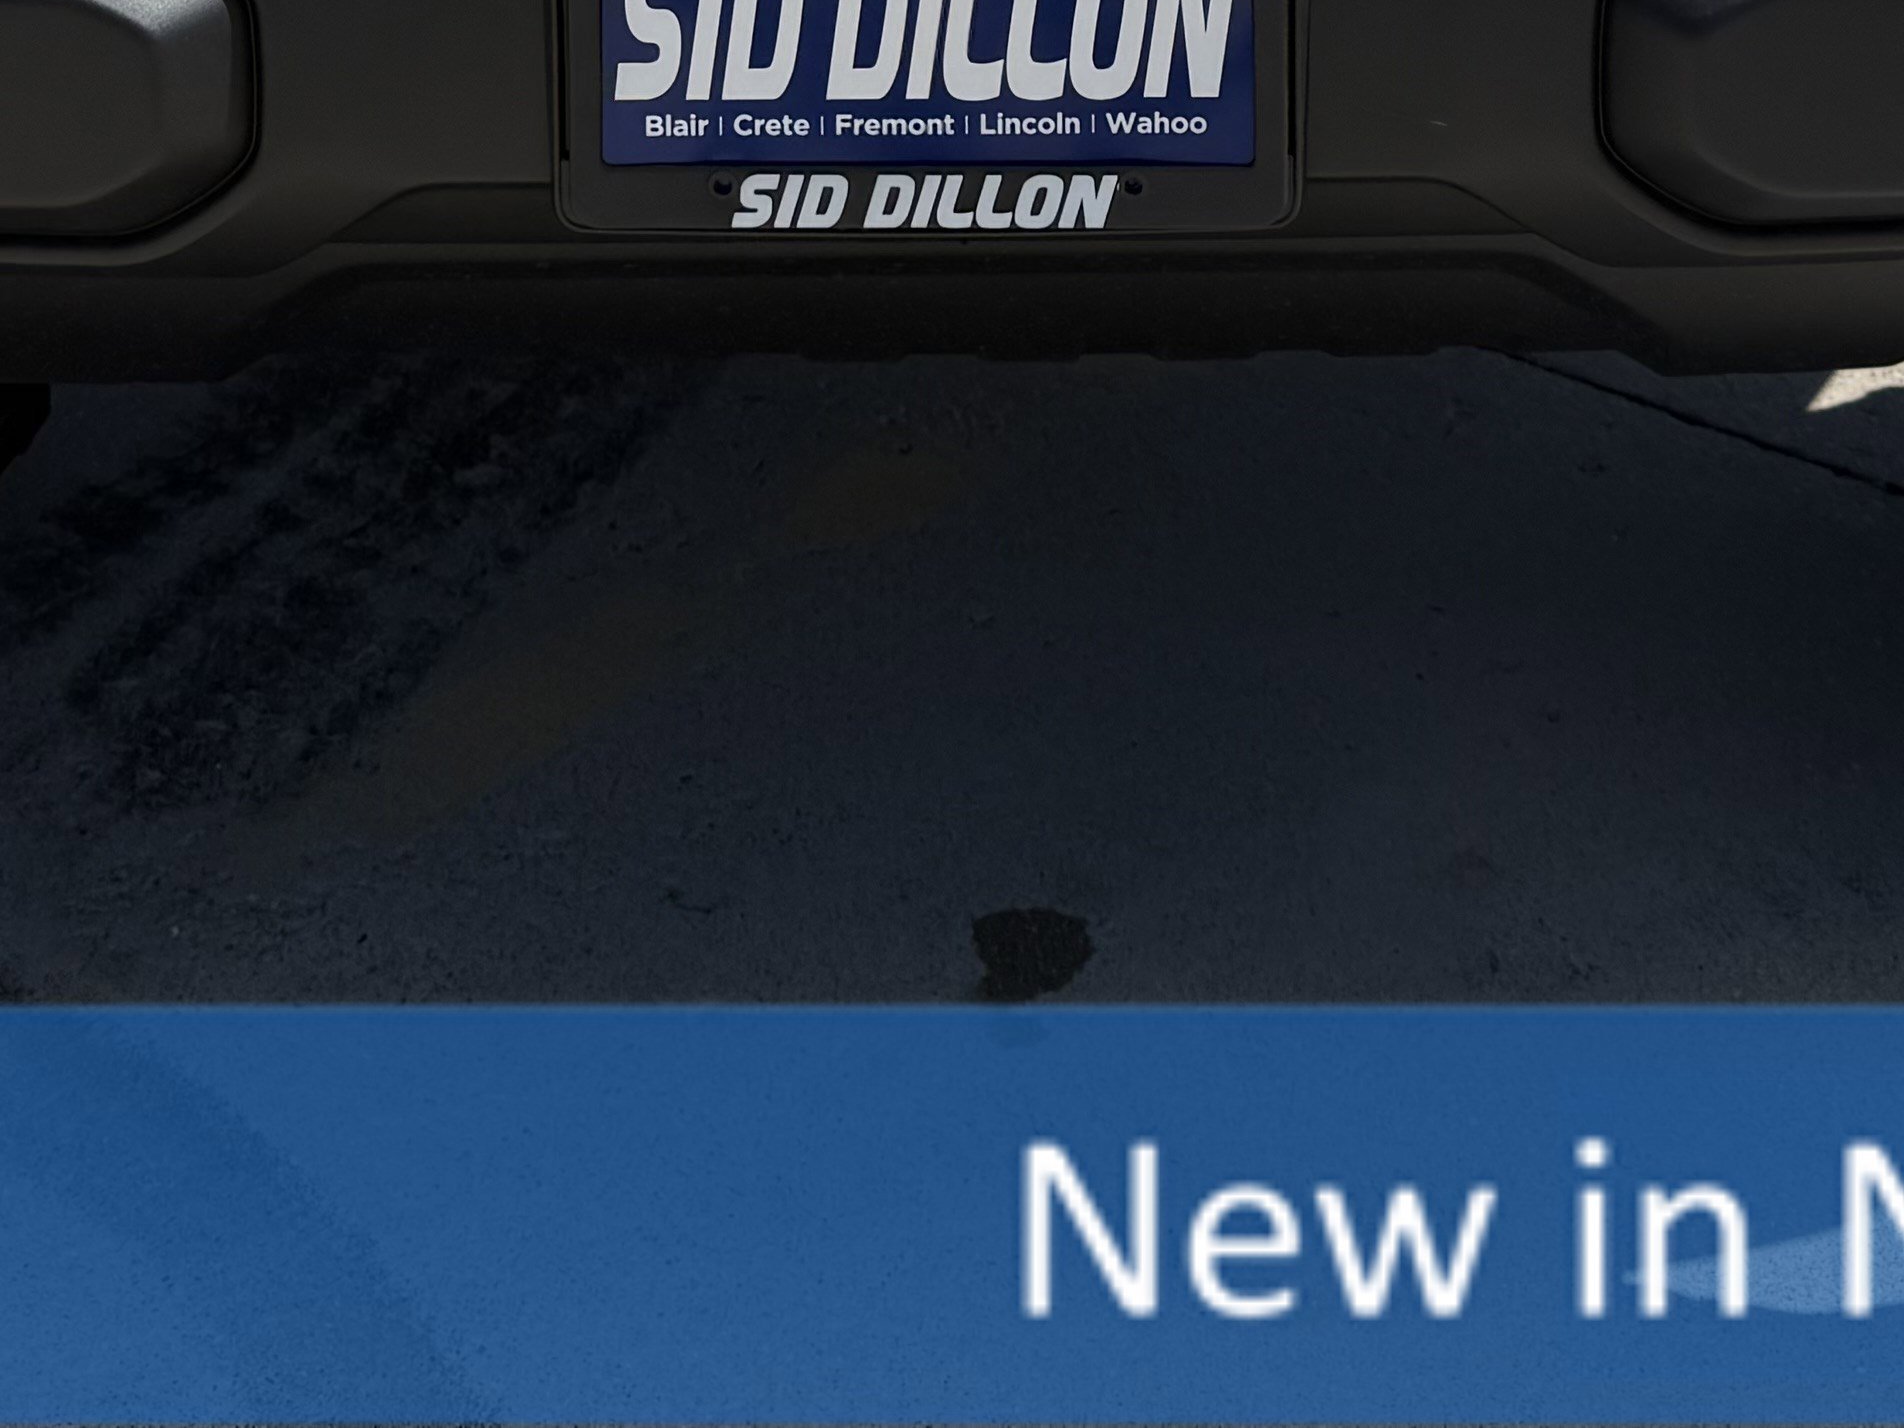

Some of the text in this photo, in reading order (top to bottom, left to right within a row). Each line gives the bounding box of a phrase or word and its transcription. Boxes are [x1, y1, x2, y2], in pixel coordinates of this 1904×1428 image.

[645, 110, 1208, 137] Blair Crete Fremont Lincoln Wahoo
[731, 173, 1118, 229] SID DILLON
